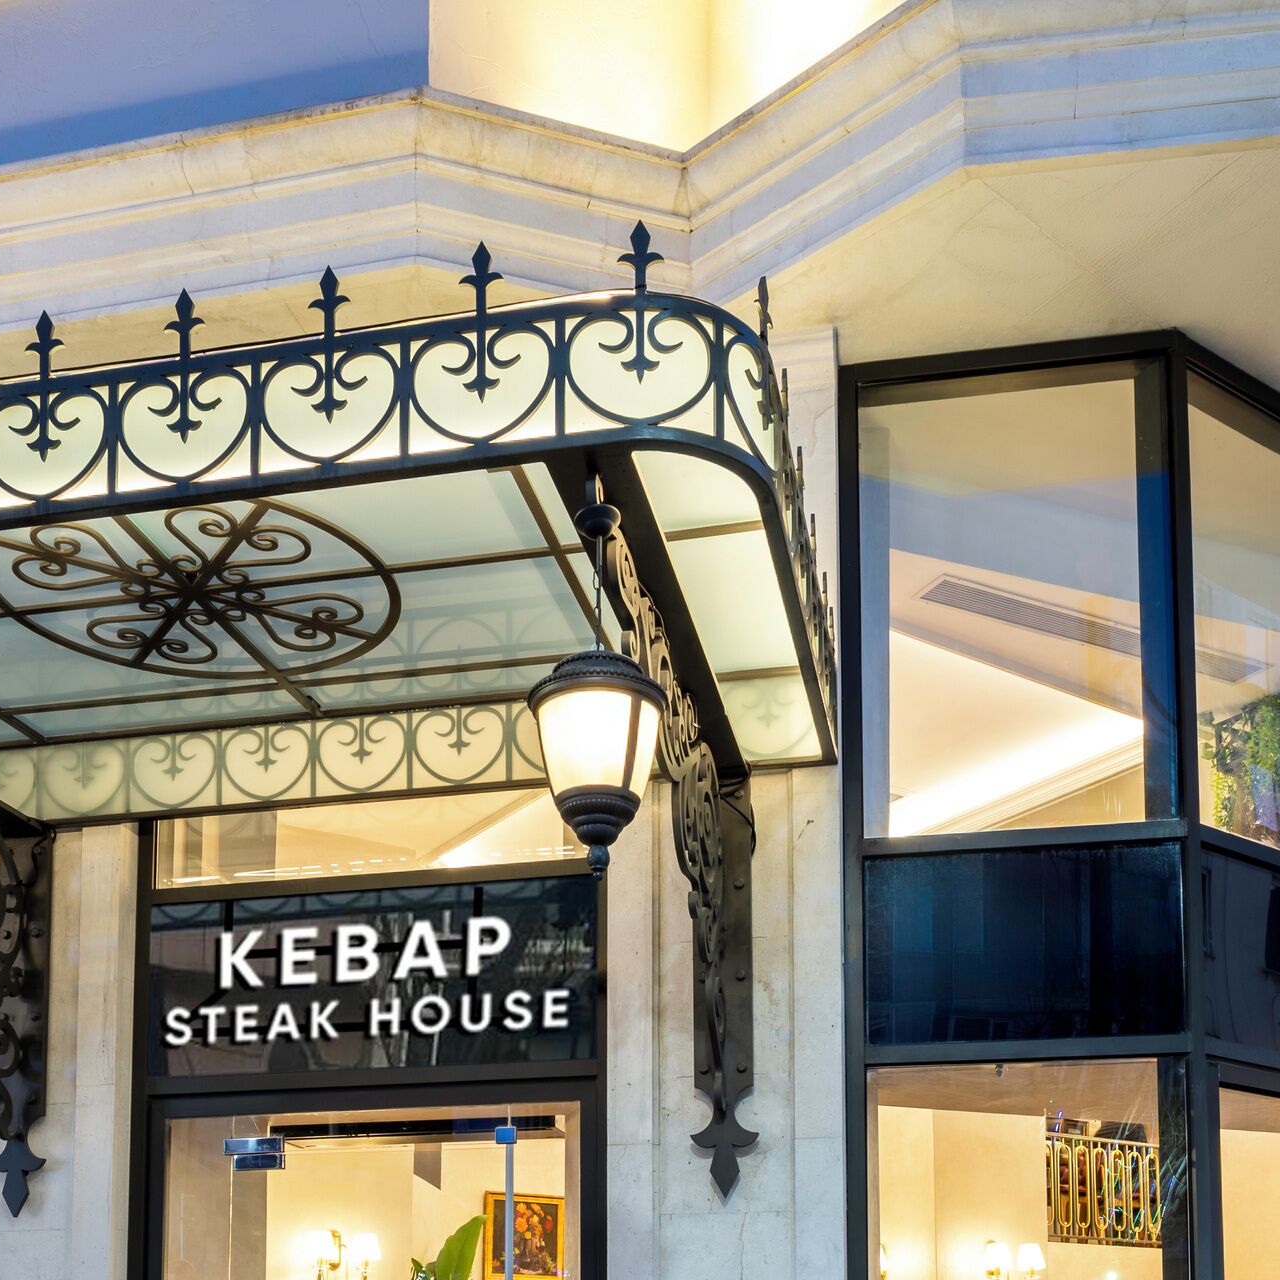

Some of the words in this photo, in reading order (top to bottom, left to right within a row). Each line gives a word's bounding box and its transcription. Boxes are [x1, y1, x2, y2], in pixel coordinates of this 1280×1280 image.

[219, 916, 512, 988] KEBAP
[165, 1000, 339, 1046] STEAK
[369, 989, 570, 1036] HOUSE
